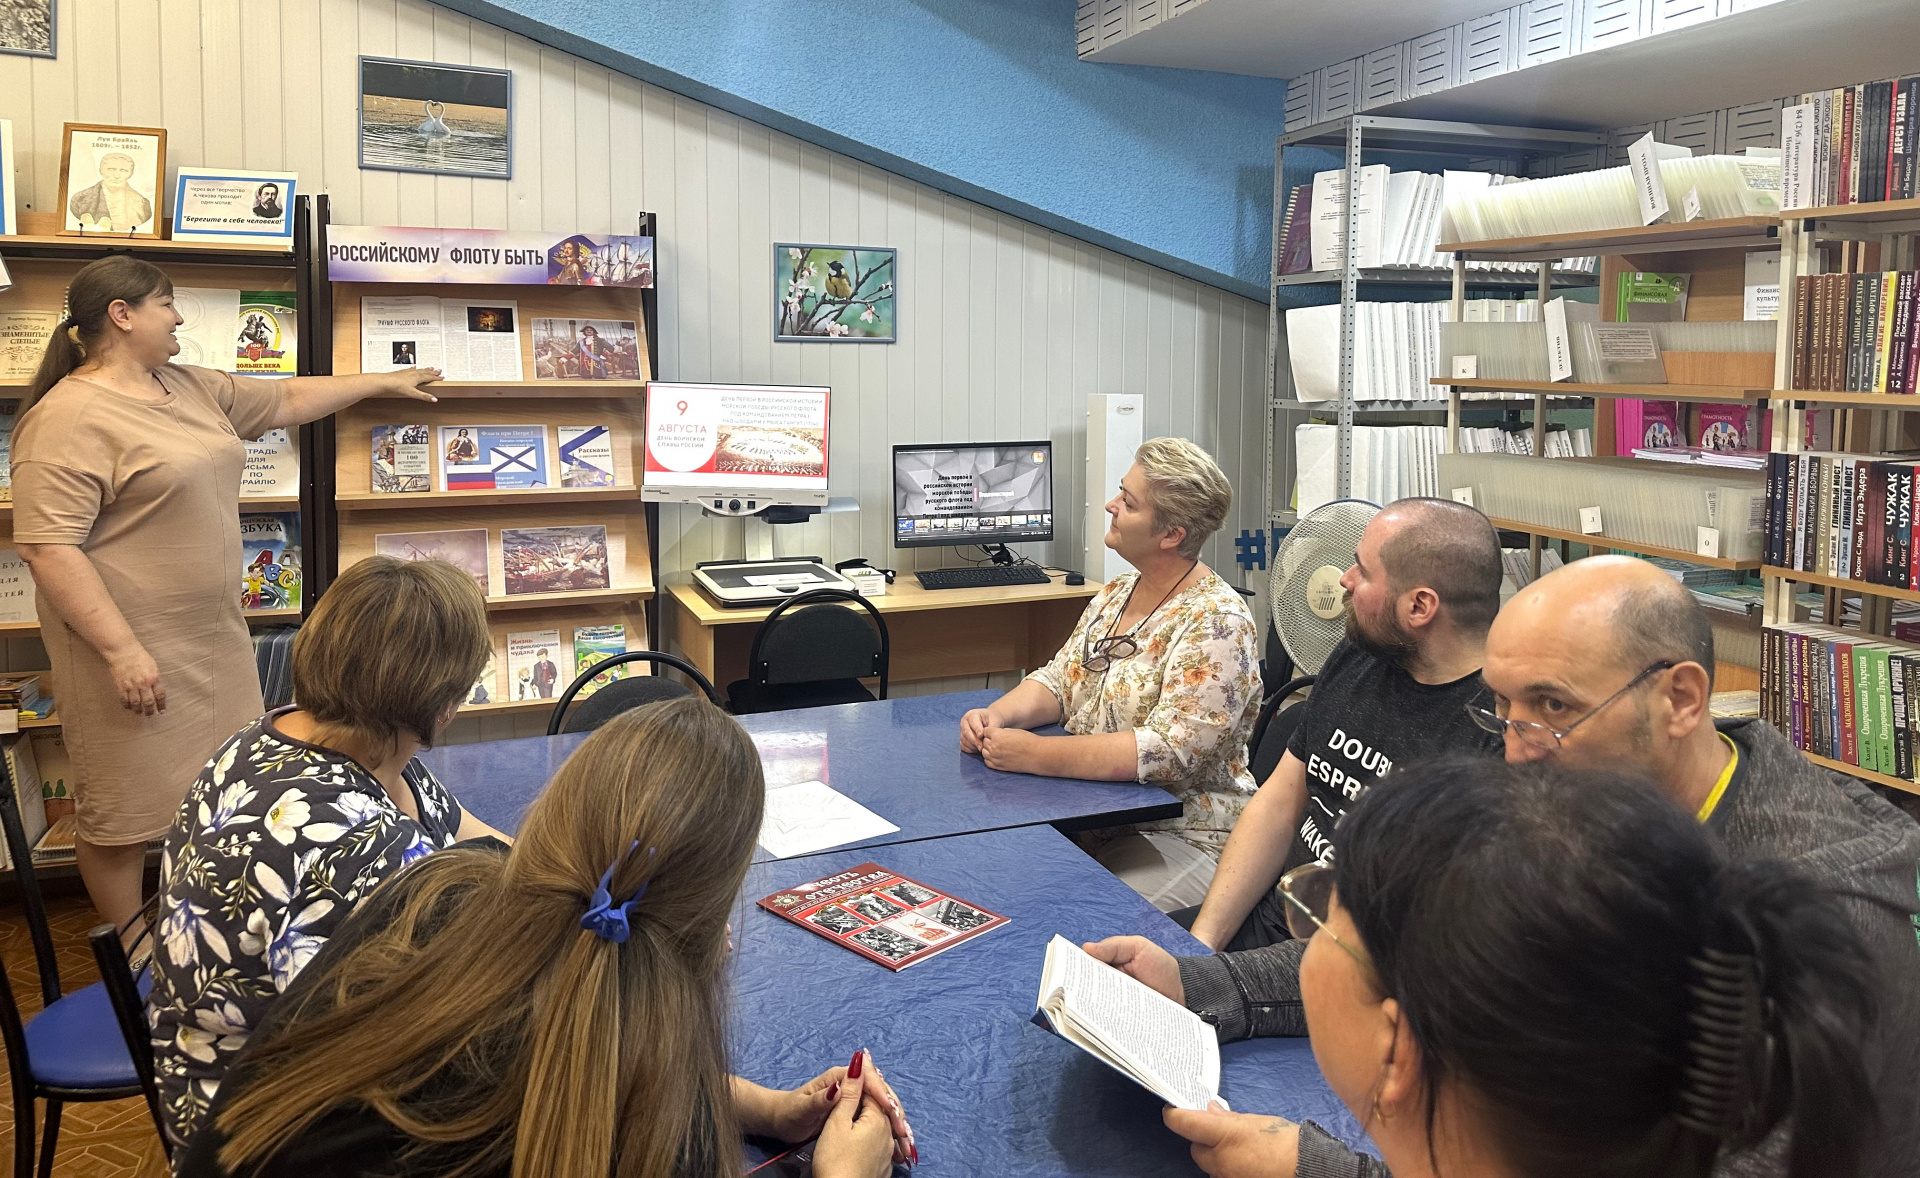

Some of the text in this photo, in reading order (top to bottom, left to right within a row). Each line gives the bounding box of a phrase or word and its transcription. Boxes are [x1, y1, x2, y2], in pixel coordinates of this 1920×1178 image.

[1834, 94, 1842, 125] ЛОШАДИ
[1855, 90, 1863, 102] БОЙ
[1909, 82, 1917, 114] воронов
[1794, 121, 1802, 137] (2)6
[1796, 109, 1803, 119] 84
[1824, 124, 1830, 133] ДА
[1894, 92, 1906, 154] ДЕРСУ УЗАЛА
[1832, 125, 1840, 153] ПЛАЧУТ
[1853, 132, 1861, 162] СЫНОВЬЯ
[1905, 117, 1915, 154] Шестёрка
[1641, 153, 1656, 209] ВОЕННАЯ ПРОЗА
[329, 242, 544, 266] РОССИЙСКОМУ ФЛОТУ БЫТЬ
[1852, 280, 1864, 347] ТАЙНЫЕ ФРЕГАТЫ
[1865, 278, 1877, 347] ТАЙНЫЕ ФРЕГАТЫ
[1879, 278, 1889, 321] НАМЕРЕНИЯ
[1900, 274, 1912, 337] Последний рассвет
[1797, 301, 1805, 349] АФРИКАНСКИЙ
[1813, 300, 1821, 349] АФРИКАНСКИЙ
[1824, 299, 1832, 348] АФРИКАНСКИЙ
[1837, 300, 1845, 349] АФРИКАНСКИЙ
[1912, 322, 1920, 348] Вечный
[677, 400, 688, 415] 9
[658, 424, 707, 433] АВГУСТА
[1775, 476, 1783, 500] Фауст
[1798, 478, 1806, 507] ТОЛКАТЬ
[1844, 466, 1853, 488] МОСТ
[1856, 468, 1868, 502] Эндера
[1786, 460, 1796, 532] ПОВЕЛИТЕЛЬ МУХ
[1807, 462, 1818, 533] МАЛЕНЬКИЙ ОБОРВЫШ
[1831, 465, 1841, 529] ГЛИНЯНЫЙ МОСТ
[1842, 489, 1852, 530] ГЛИНЯНЫЙ
[241, 523, 282, 534] ЗБУКА
[1820, 493, 1828, 536] СЕРЕБРЯНЫЕ
[1855, 503, 1865, 526] Игра
[1886, 472, 1898, 564] Кинг ЧУЖАК
[1899, 474, 1911, 567] Кинг ЧУЖАК
[516, 642, 559, 650] приключения
[1761, 632, 1769, 671] башмачника
[1790, 638, 1800, 702] Гамбит королевы
[1841, 653, 1849, 679] ХОЛМОВ
[1858, 655, 1869, 689] Лукреция
[1876, 659, 1888, 693] Лукреция
[1890, 659, 1902, 692] ОРУЖИЕ!
[1843, 679, 1851, 696] СЕМИ
[1844, 697, 1852, 729] МАДОННА
[1861, 690, 1872, 735] Опороченная
[1879, 694, 1891, 740] Опороченная
[1892, 693, 1906, 728] ПРОЩАЙ,
